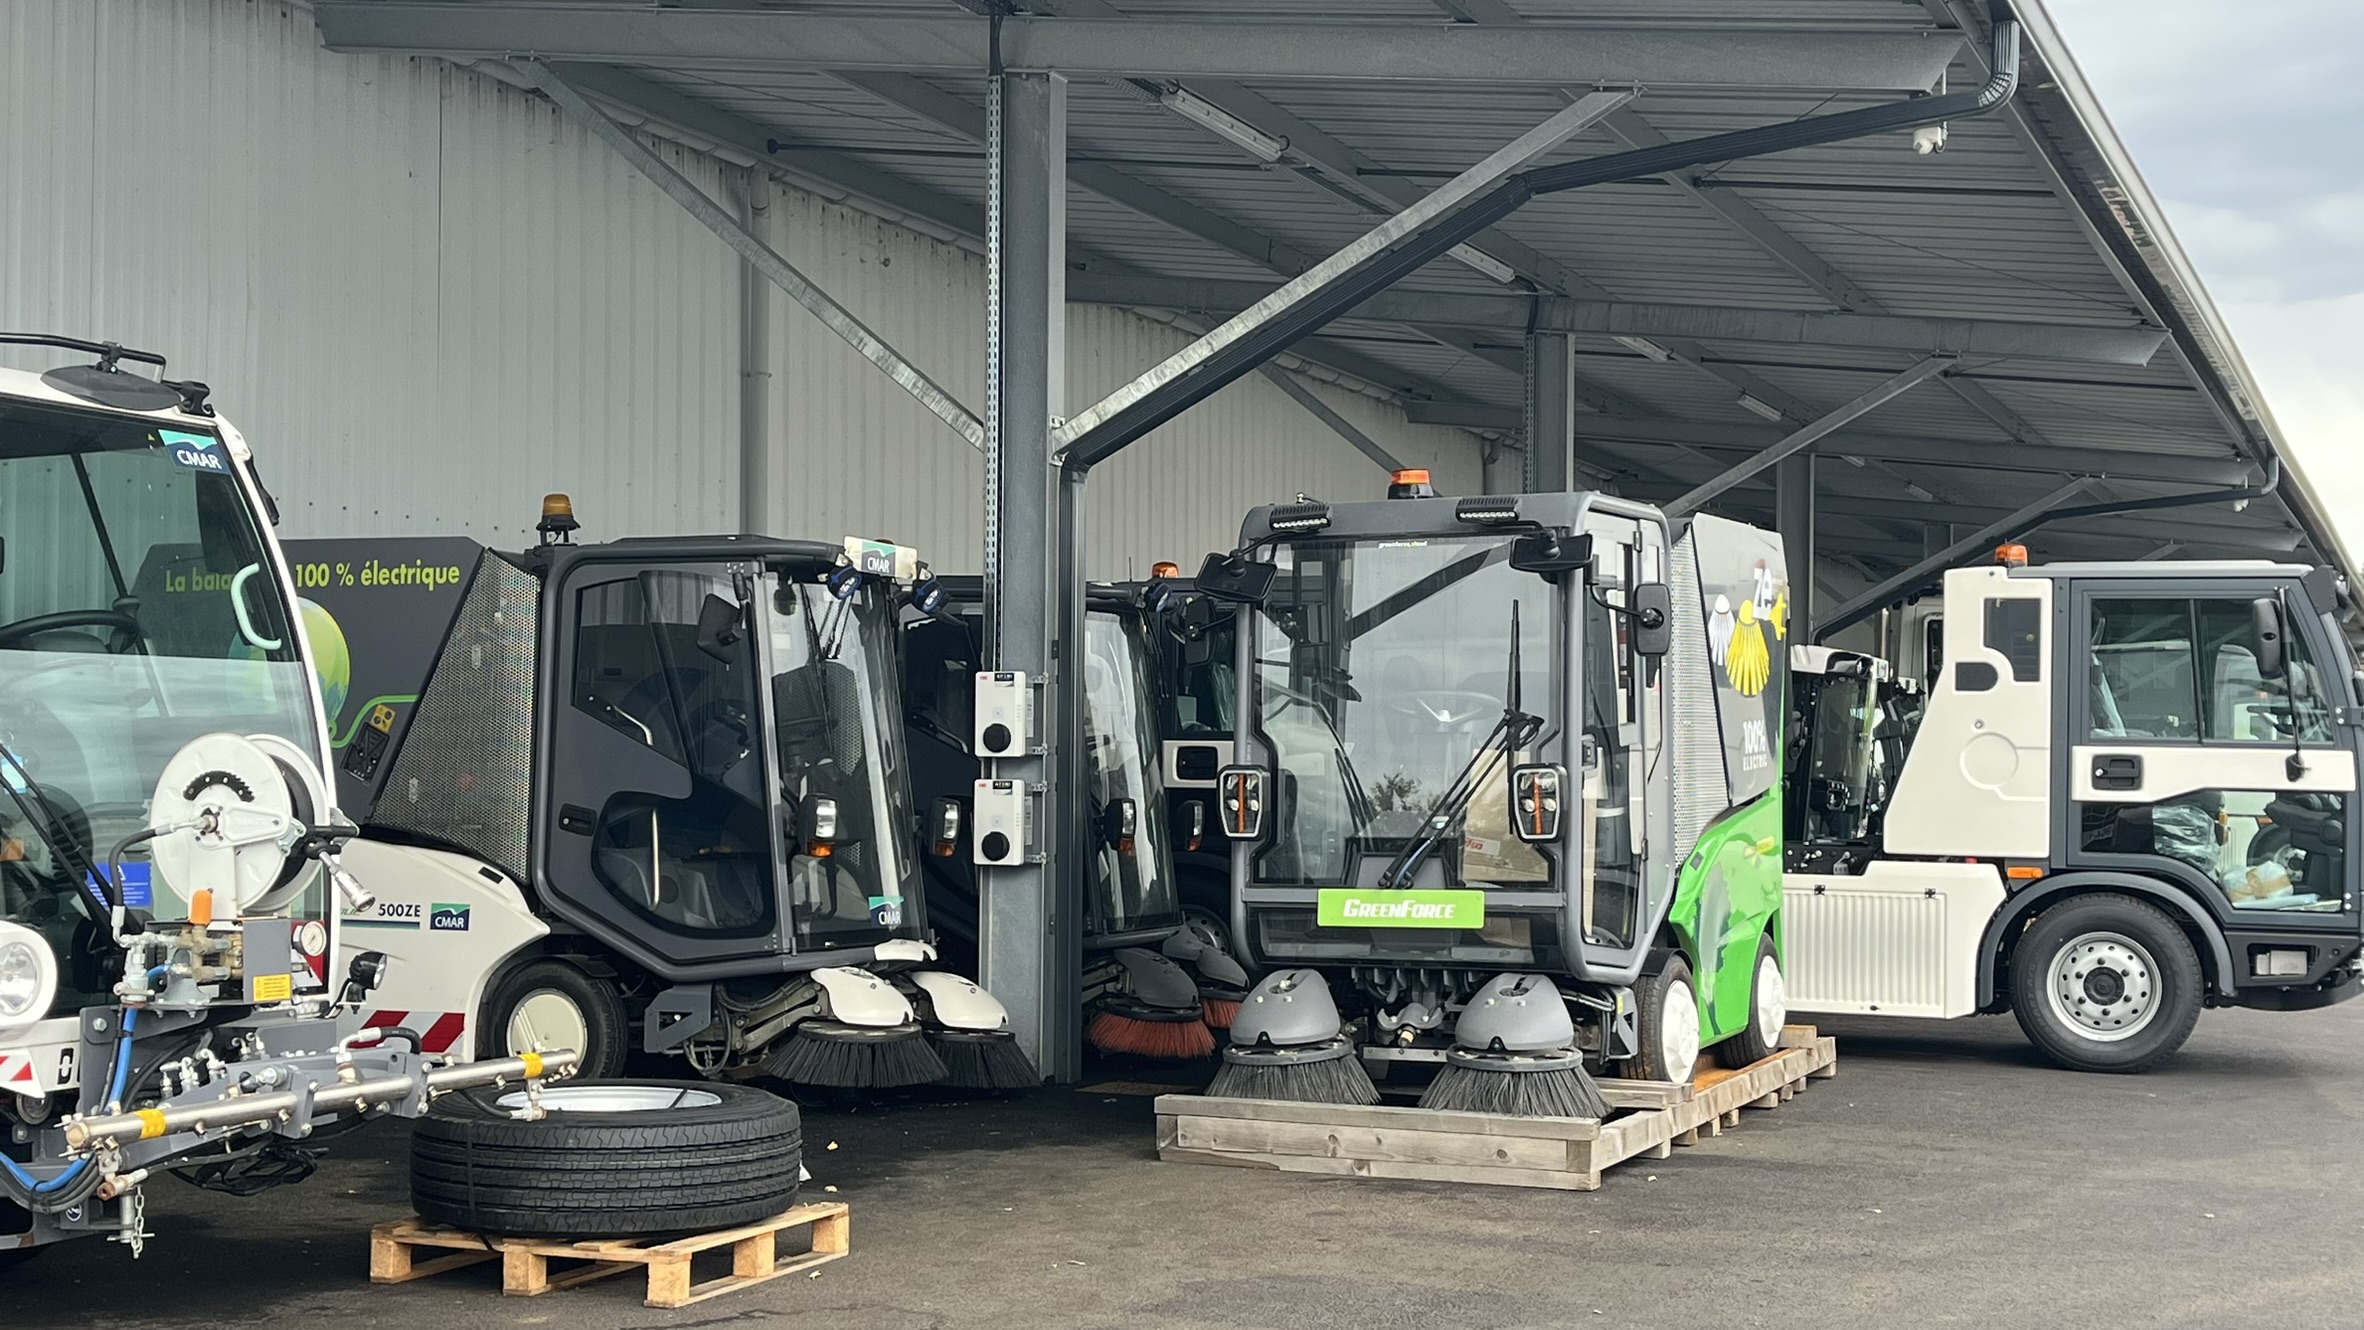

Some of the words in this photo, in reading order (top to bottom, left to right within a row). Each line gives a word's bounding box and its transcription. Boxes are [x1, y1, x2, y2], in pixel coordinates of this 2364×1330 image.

[176, 449, 222, 470] CMAR
[867, 556, 890, 573] CMAR
[165, 569, 186, 592] La
[295, 562, 330, 588] 100
[336, 562, 354, 587] %
[360, 558, 460, 591] électrique
[1743, 719, 1766, 754] 100%
[378, 903, 421, 917] 500ZE
[878, 910, 902, 926] CMAR
[434, 916, 464, 928] CMAR
